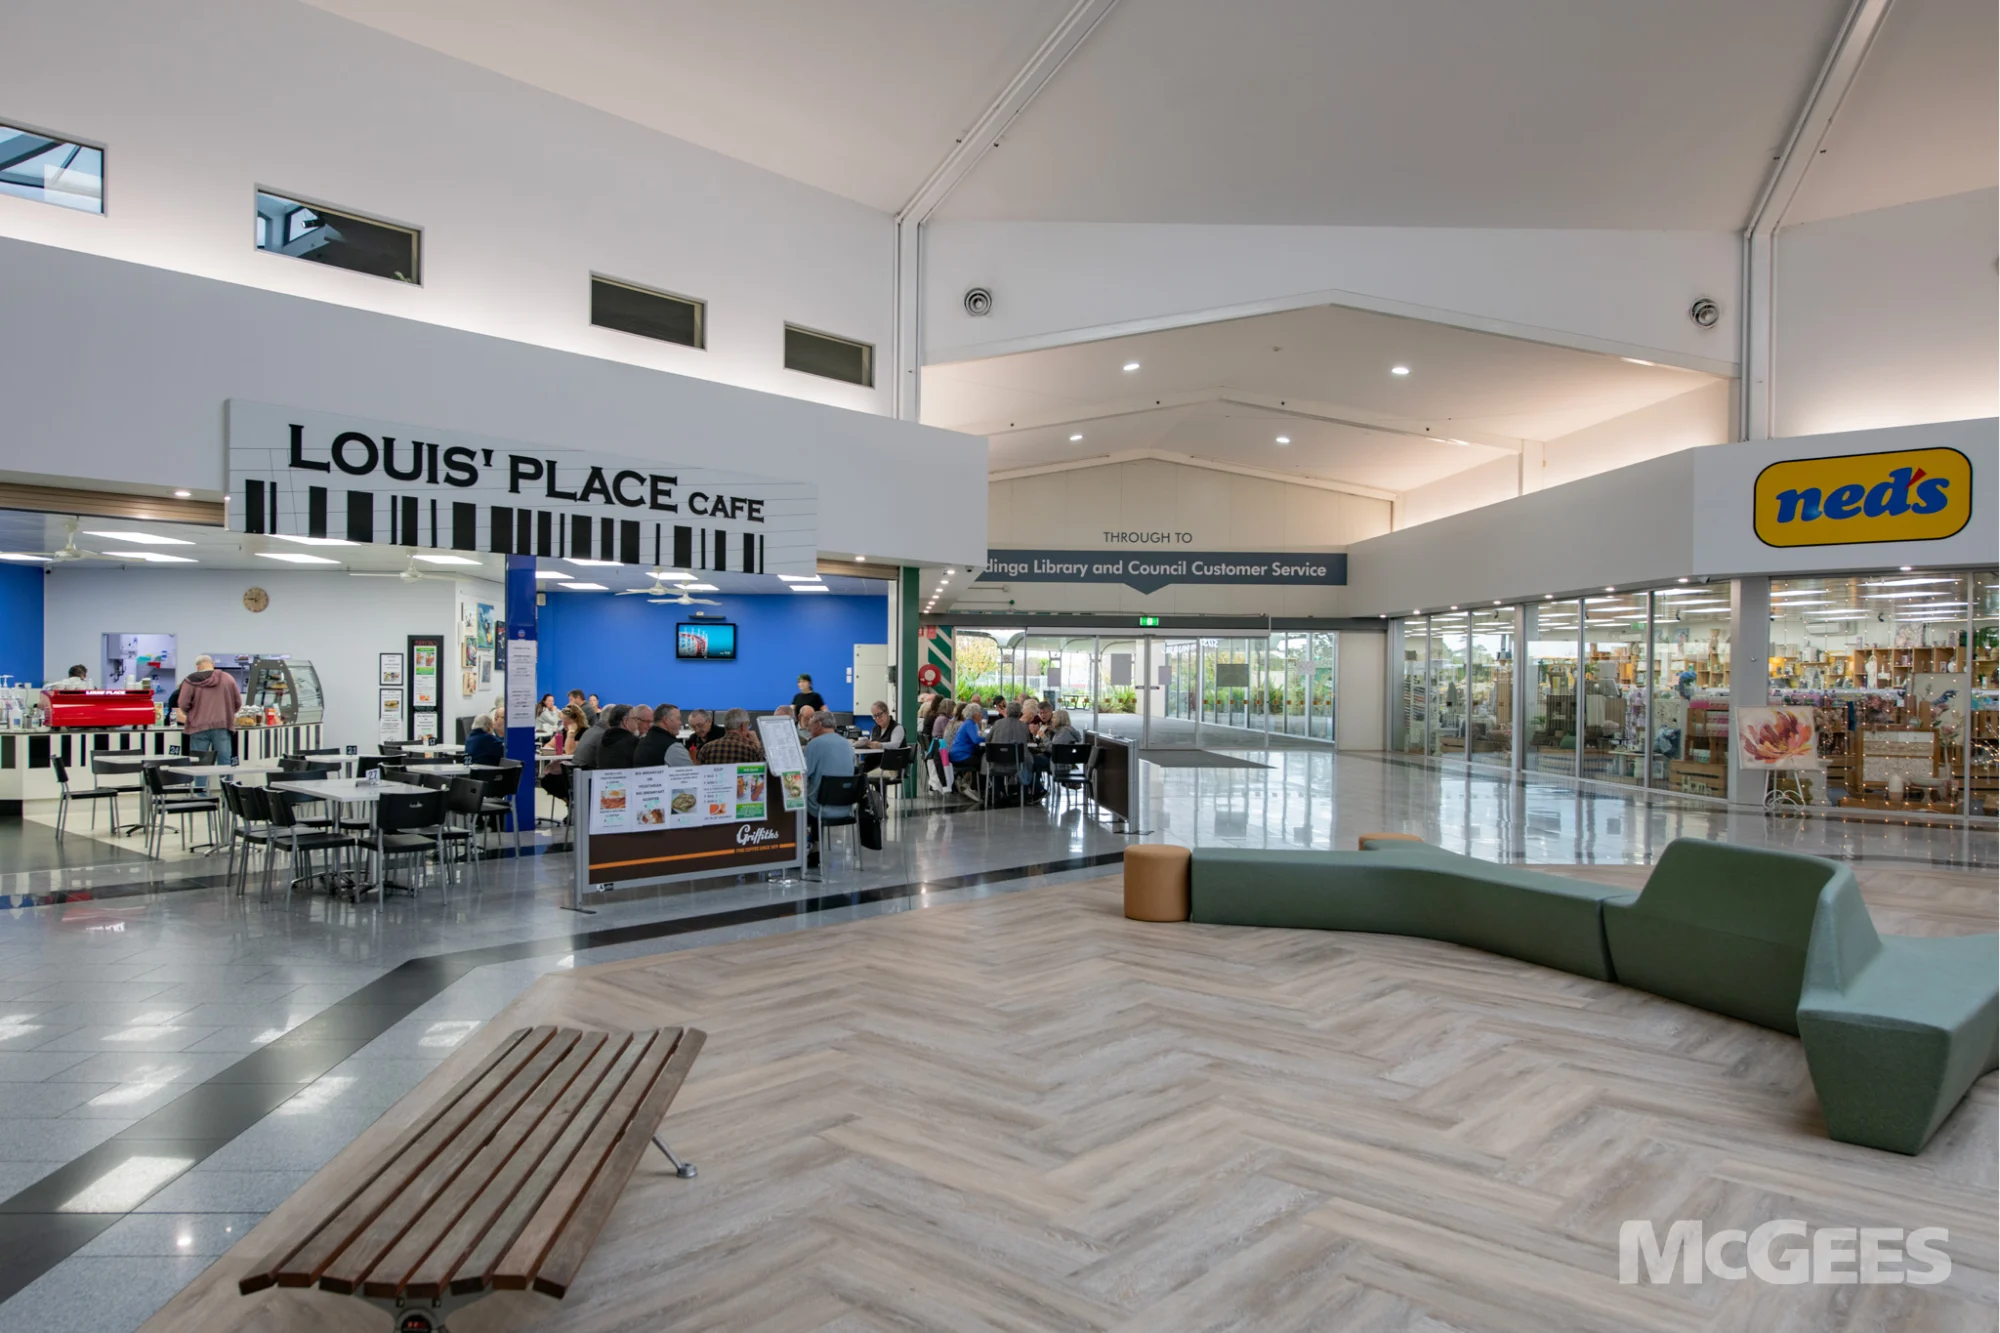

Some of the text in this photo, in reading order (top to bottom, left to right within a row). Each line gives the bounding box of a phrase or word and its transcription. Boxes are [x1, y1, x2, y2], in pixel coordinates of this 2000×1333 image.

[288, 424, 765, 524] LOUIS' PLACE CAFE
[1776, 467, 1950, 523] ned's
[1103, 531, 1193, 544] THROUGH TO
[1033, 559, 1087, 577] Library
[1092, 560, 1124, 575] and
[1128, 560, 1187, 576] Council
[1193, 562, 1268, 577] Customer
[1272, 563, 1327, 577] Service
[368, 770, 377, 780] 27
[736, 824, 779, 845] Griffiths
